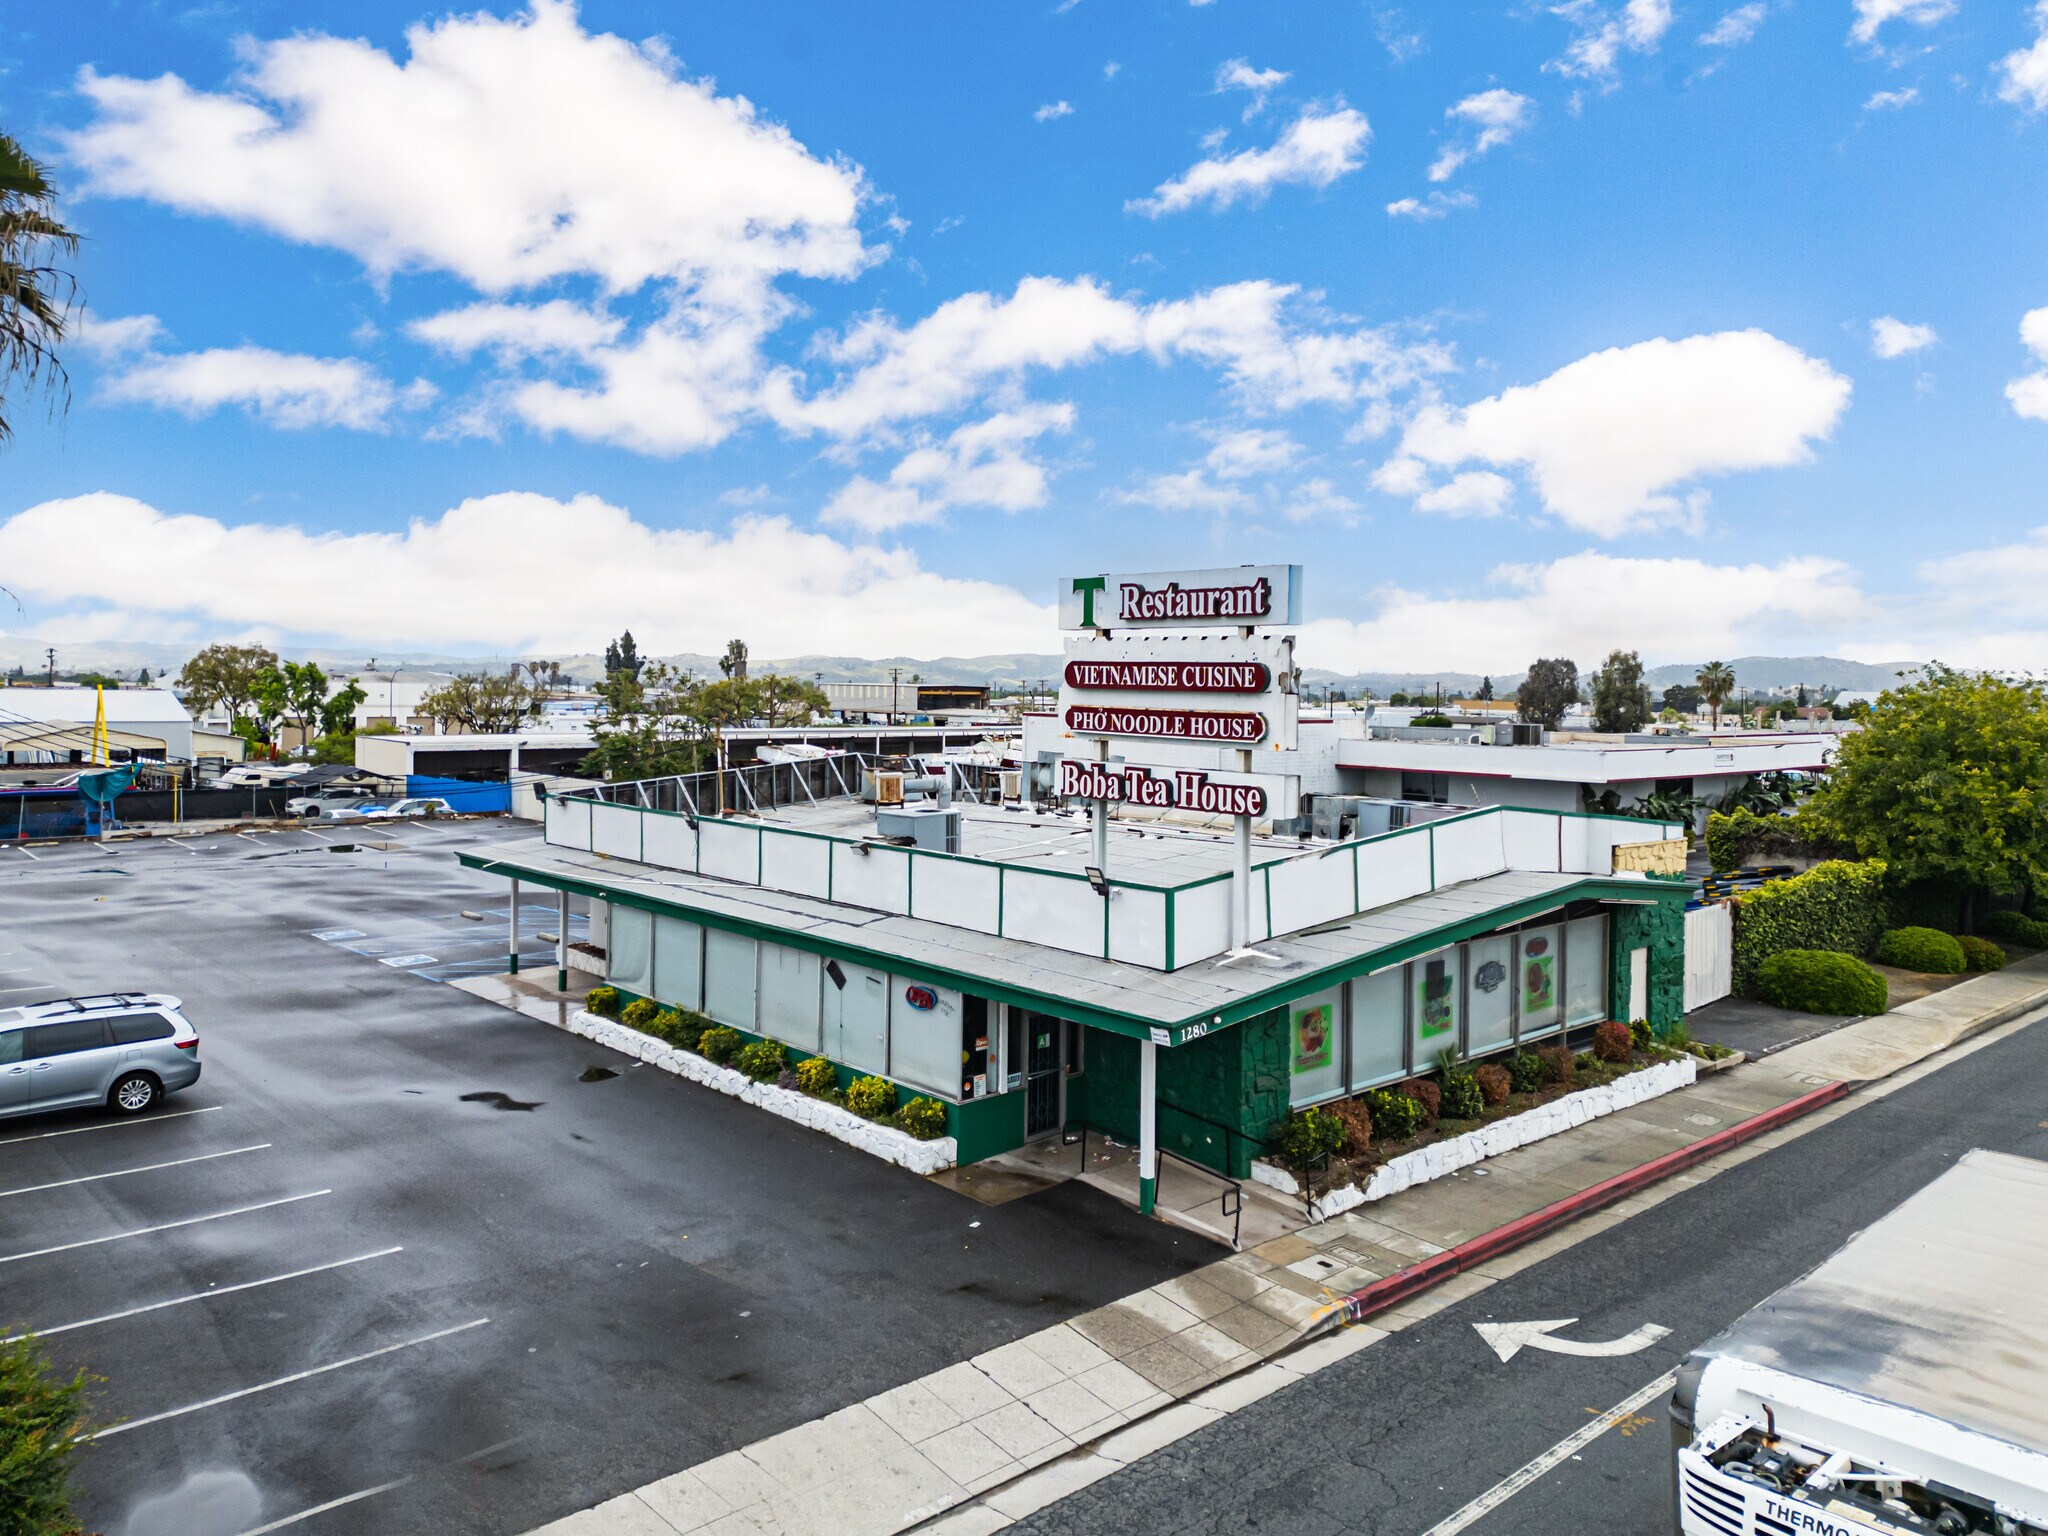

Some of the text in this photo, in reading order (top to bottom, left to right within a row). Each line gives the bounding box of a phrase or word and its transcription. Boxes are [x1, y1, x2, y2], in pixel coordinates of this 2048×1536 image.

[1073, 577, 1267, 626] T Restaurant
[1073, 665, 1256, 688] VIETNAMESE CUISINE
[1111, 713, 1185, 735] NOODLE
[1190, 716, 1256, 738] HOUSE
[1062, 764, 1261, 816] Boba Tea House
[1039, 1037, 1045, 1046] A
[1181, 1022, 1207, 1042] 1280
